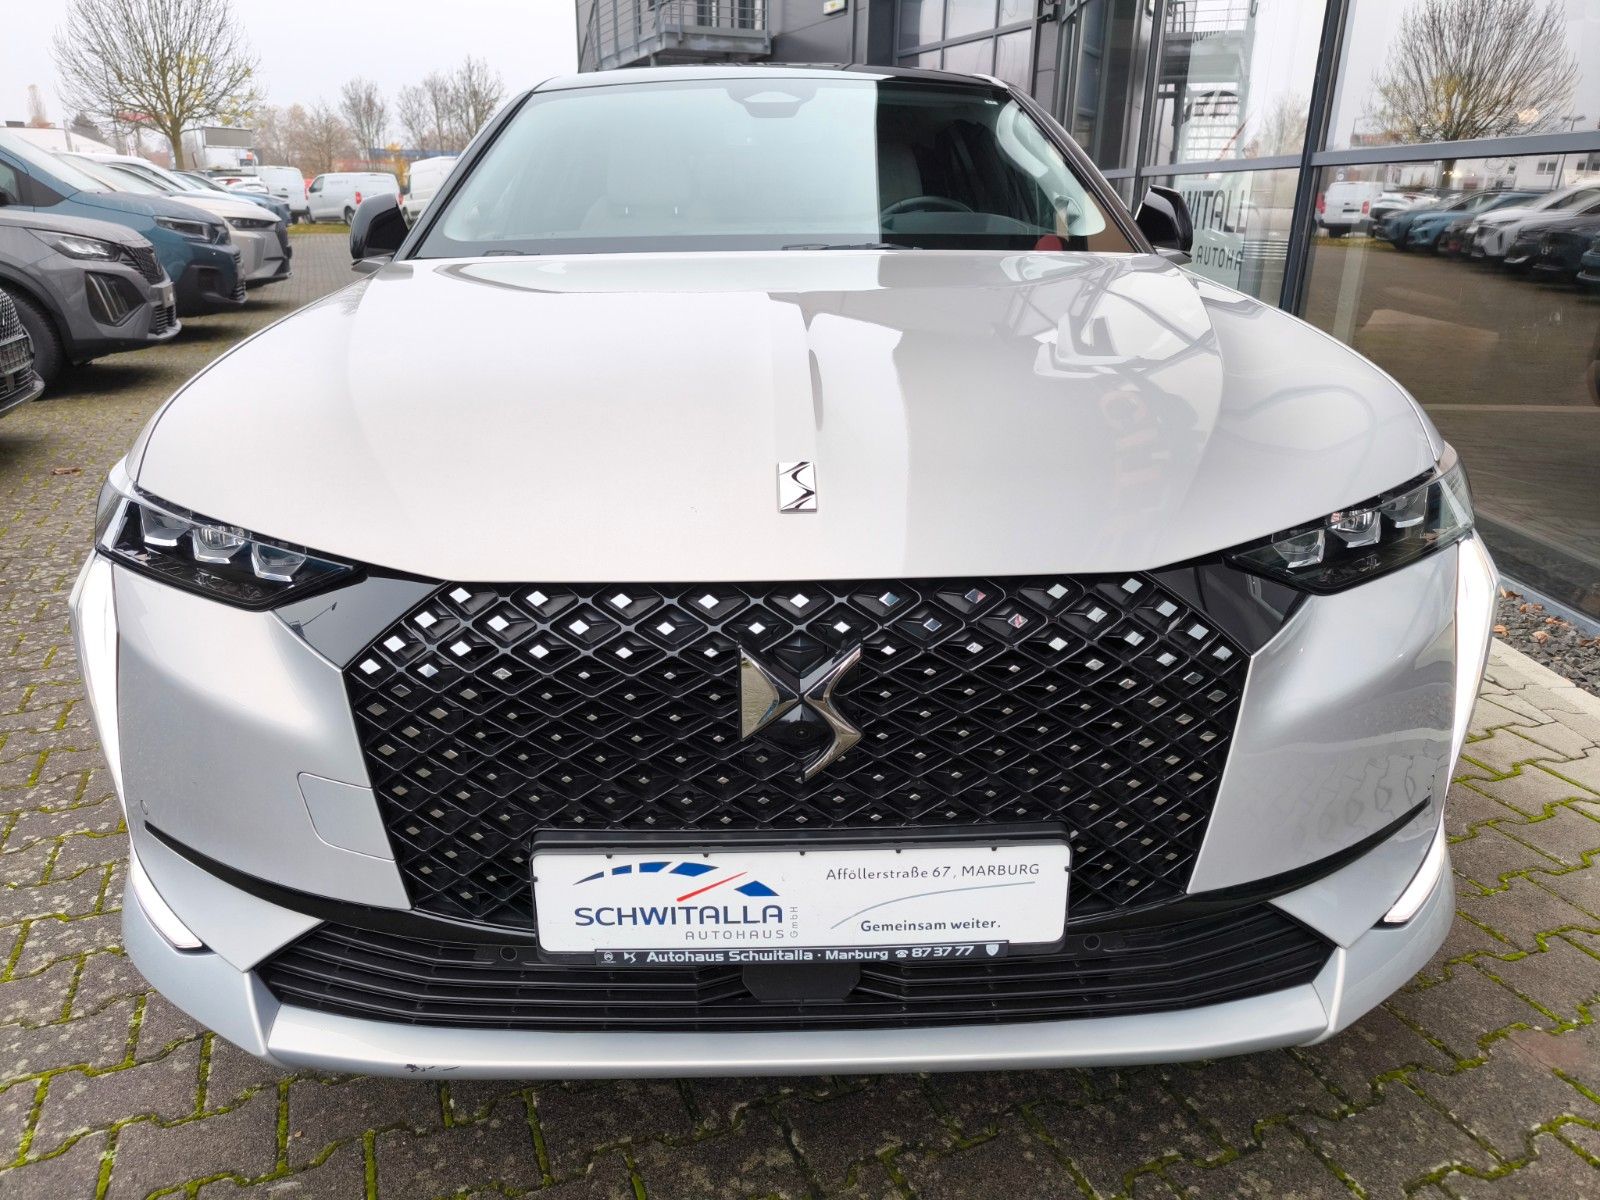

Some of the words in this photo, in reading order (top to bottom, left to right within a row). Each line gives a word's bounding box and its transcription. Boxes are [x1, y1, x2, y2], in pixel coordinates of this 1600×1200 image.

[1181, 189, 1247, 234] WITALL
[1195, 245, 1243, 271] AUTOHA
[826, 866, 928, 881] Afföllerstraße
[961, 863, 1040, 877] MARBURG
[574, 904, 784, 927] SCHWITALLA
[789, 906, 799, 938] GmbH
[860, 919, 947, 932] Gemeinsam
[950, 918, 1001, 930] weiter.
[685, 929, 785, 941] AUTOHAUS
[646, 950, 725, 963] Autohaus
[728, 949, 814, 962] Schwitalla
[825, 949, 889, 961] Marburg
